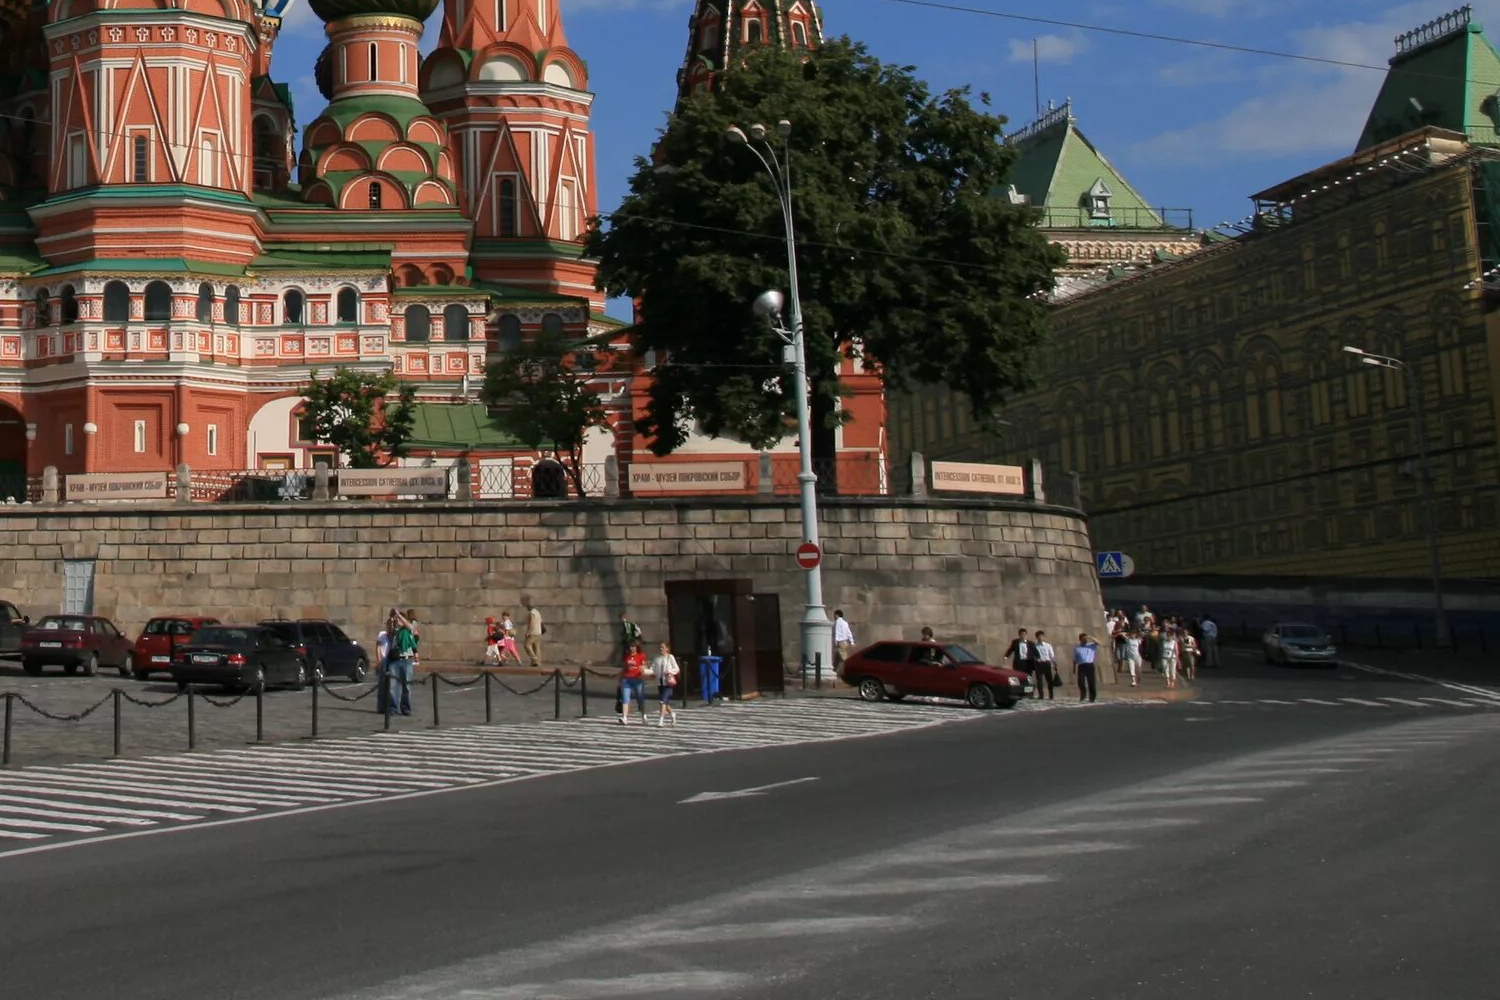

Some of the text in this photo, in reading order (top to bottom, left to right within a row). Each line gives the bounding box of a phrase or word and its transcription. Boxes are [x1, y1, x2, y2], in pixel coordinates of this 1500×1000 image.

[632, 473, 651, 483] ХРАМ
[655, 472, 677, 482] МУЗЕЙ
[720, 471, 741, 482] СОБОР
